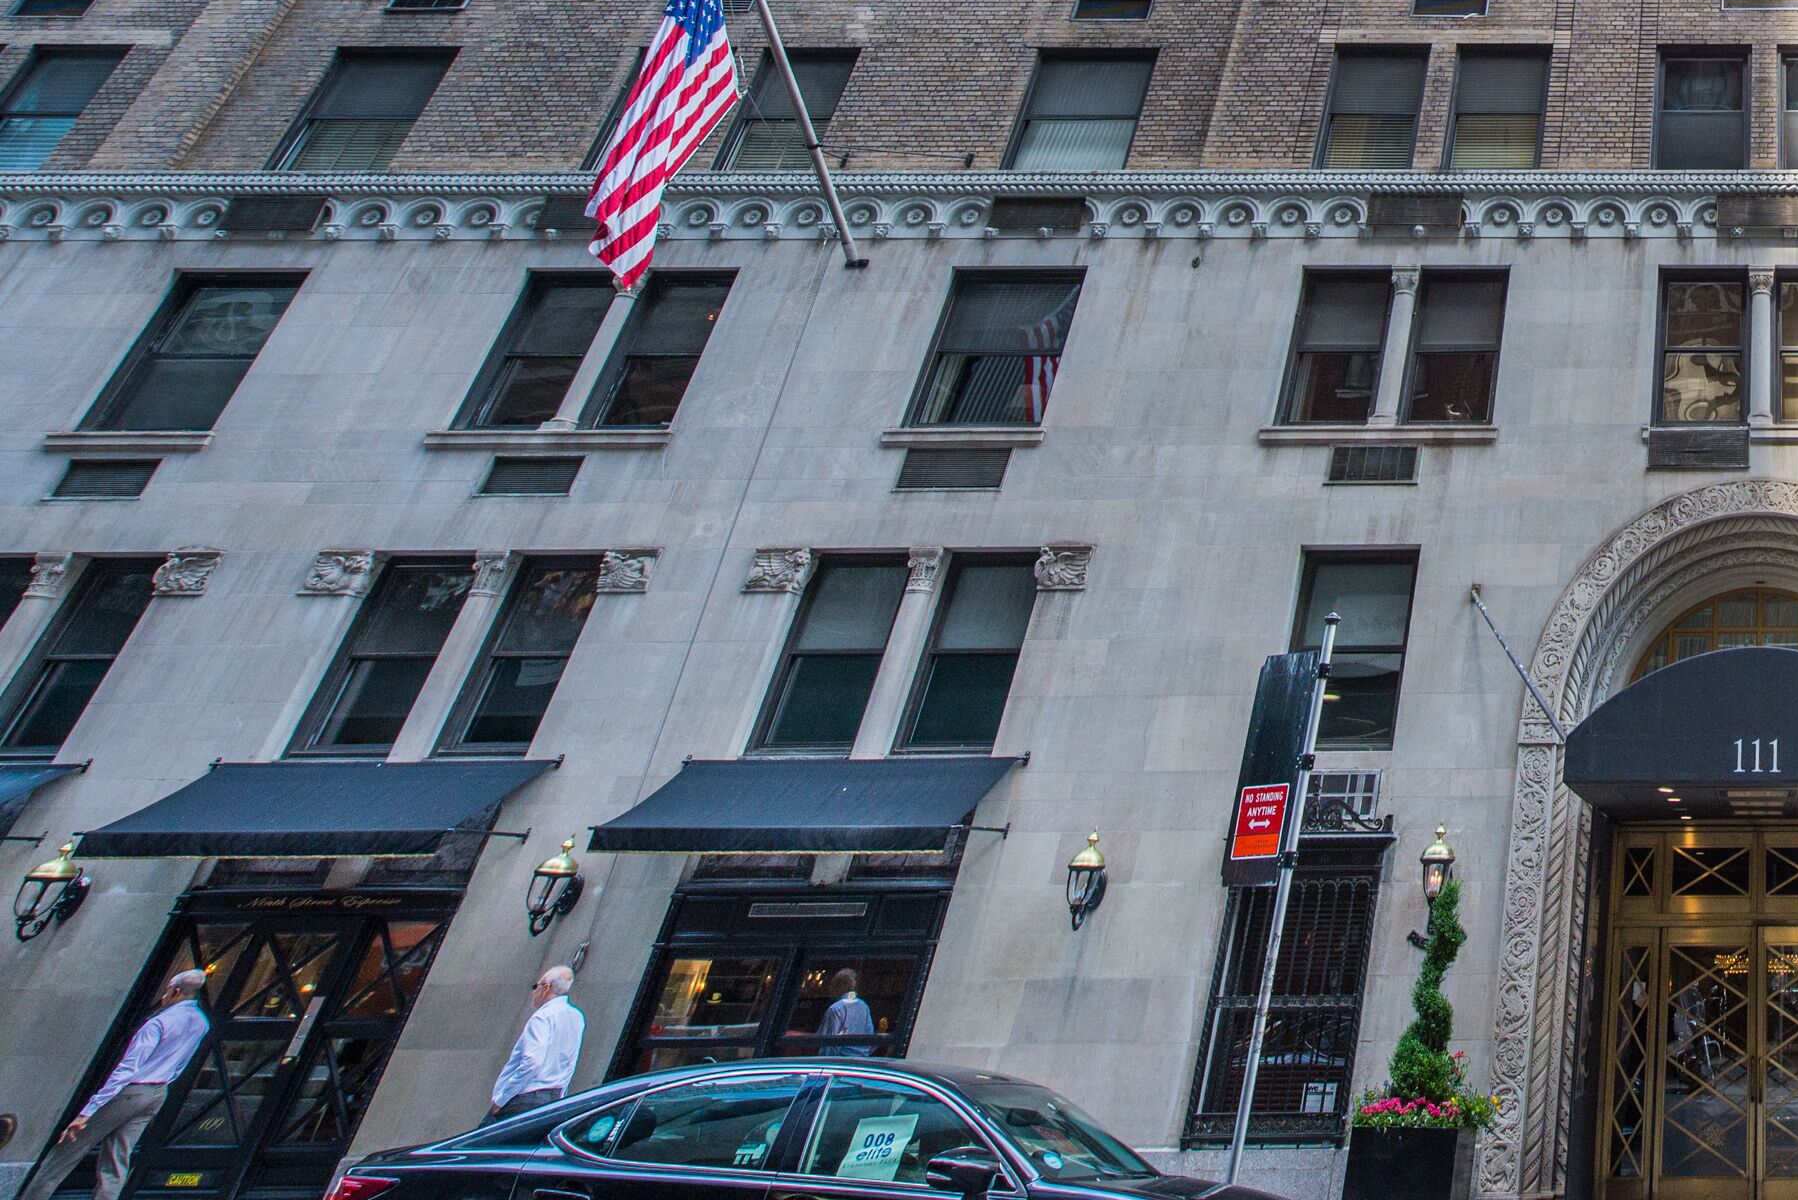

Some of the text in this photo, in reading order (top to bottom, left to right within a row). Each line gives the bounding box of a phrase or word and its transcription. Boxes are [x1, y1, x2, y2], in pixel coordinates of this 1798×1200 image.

[1733, 738, 1782, 773] 111
[1245, 791, 1284, 804] NO STANDING
[1247, 805, 1277, 817] ANYTIME
[289, 896, 337, 910] Street
[341, 895, 402, 908] Espresso
[198, 1116, 225, 1131] 109
[864, 1132, 896, 1148] 008
[856, 1146, 892, 1162] elite
[168, 1174, 201, 1185] CAUTION
